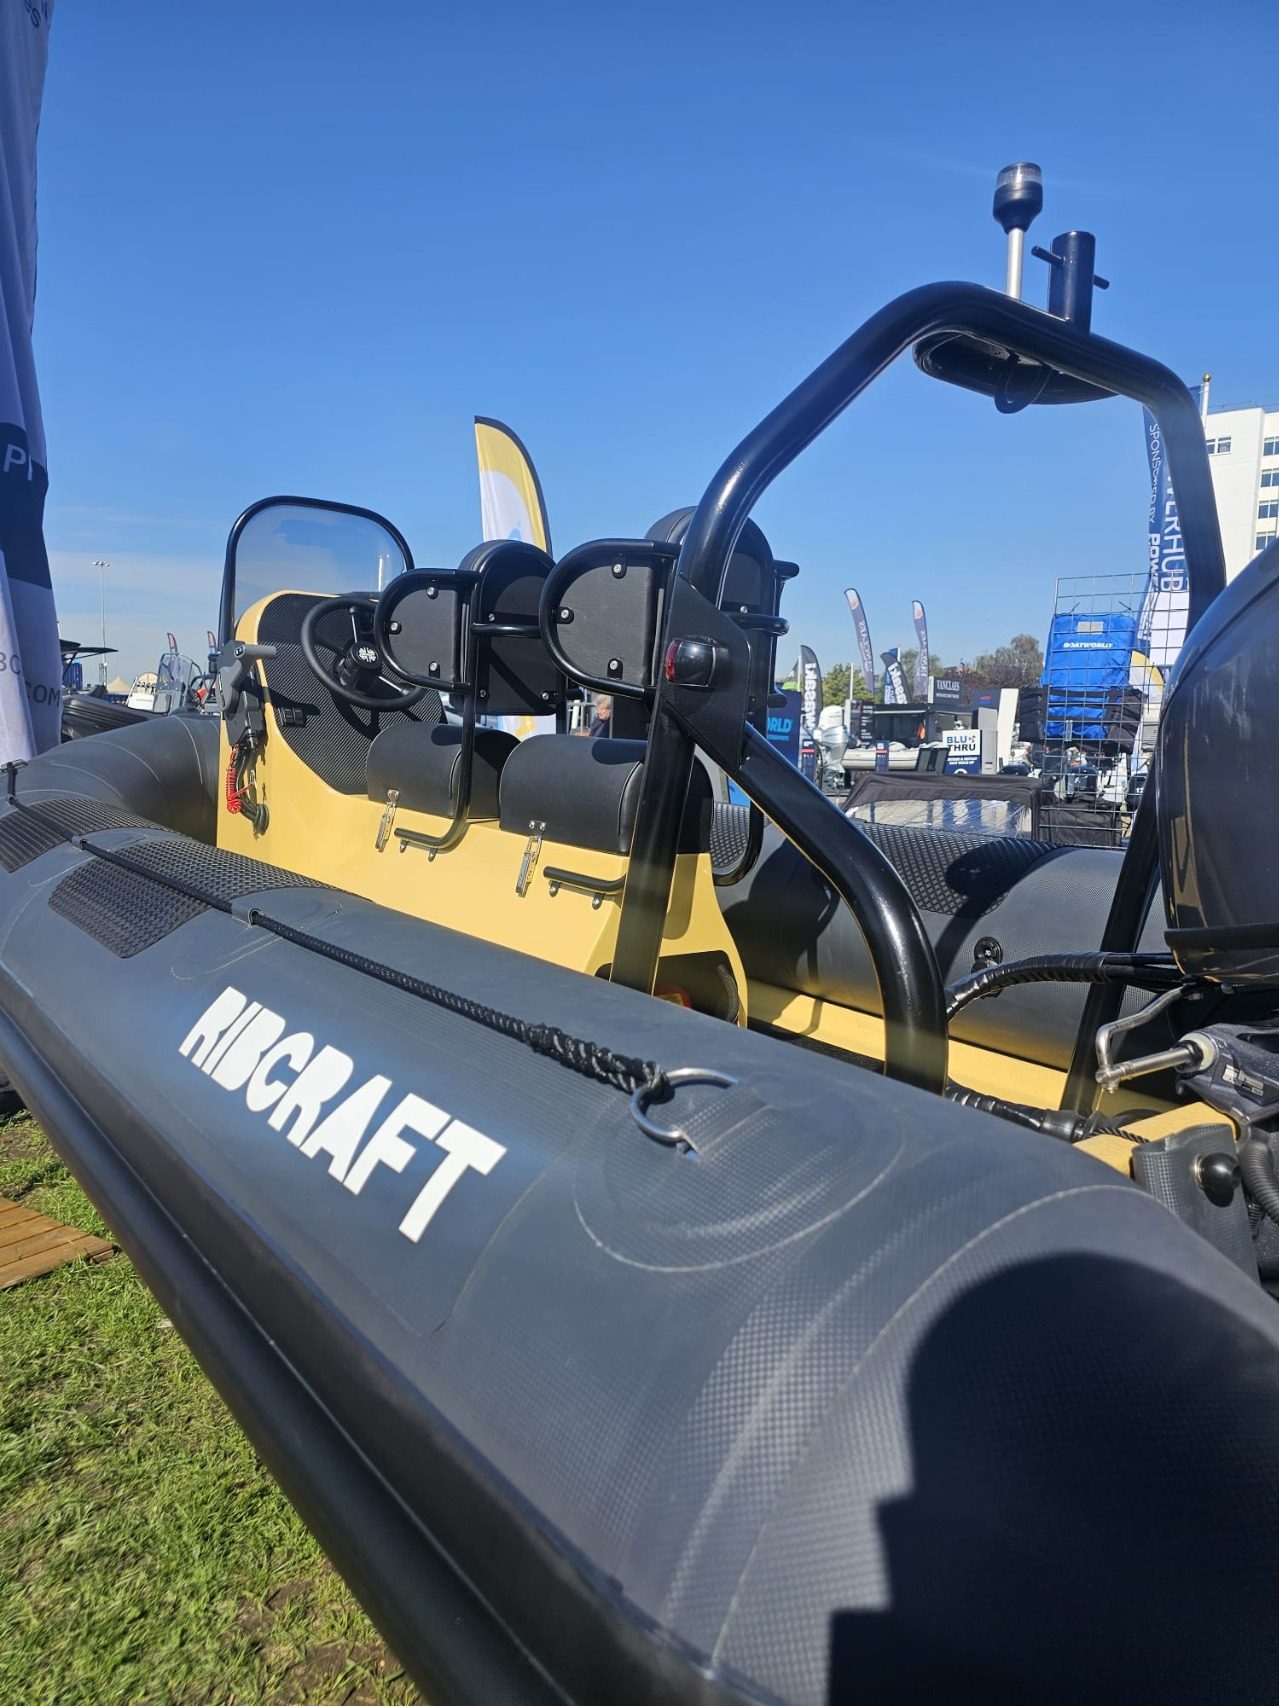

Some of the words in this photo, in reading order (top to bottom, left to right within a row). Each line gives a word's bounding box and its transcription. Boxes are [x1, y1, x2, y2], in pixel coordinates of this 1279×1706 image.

[1161, 475, 1185, 592] ERHUB
[946, 736, 967, 744] BLU
[178, 986, 507, 1243] RIBCRAFT
